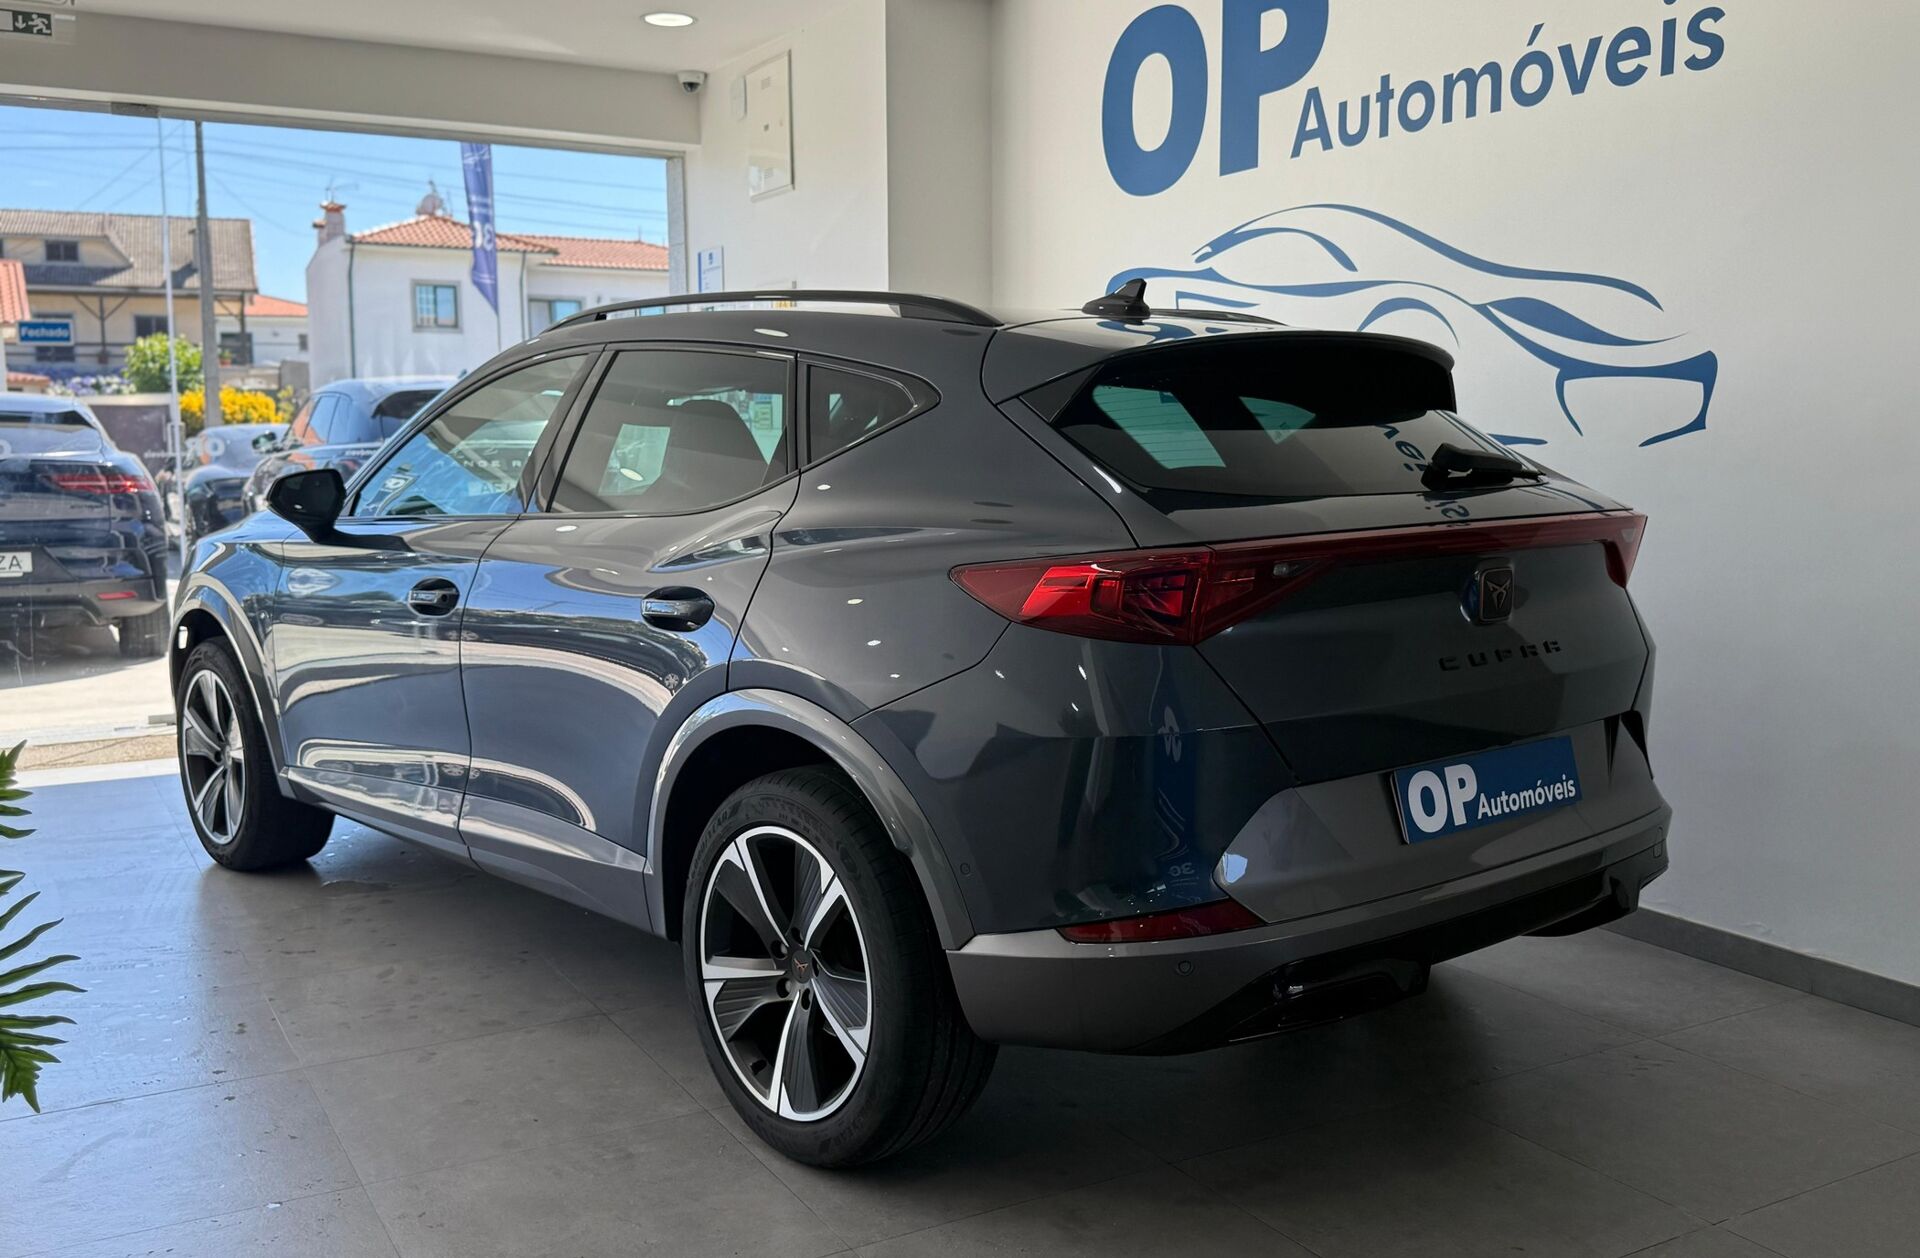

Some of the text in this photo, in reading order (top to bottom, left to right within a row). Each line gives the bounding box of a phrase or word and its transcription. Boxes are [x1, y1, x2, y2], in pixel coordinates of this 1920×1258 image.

[1102, 0, 1726, 196] OP Automóveis
[1407, 763, 1576, 833] OP Automóveis
